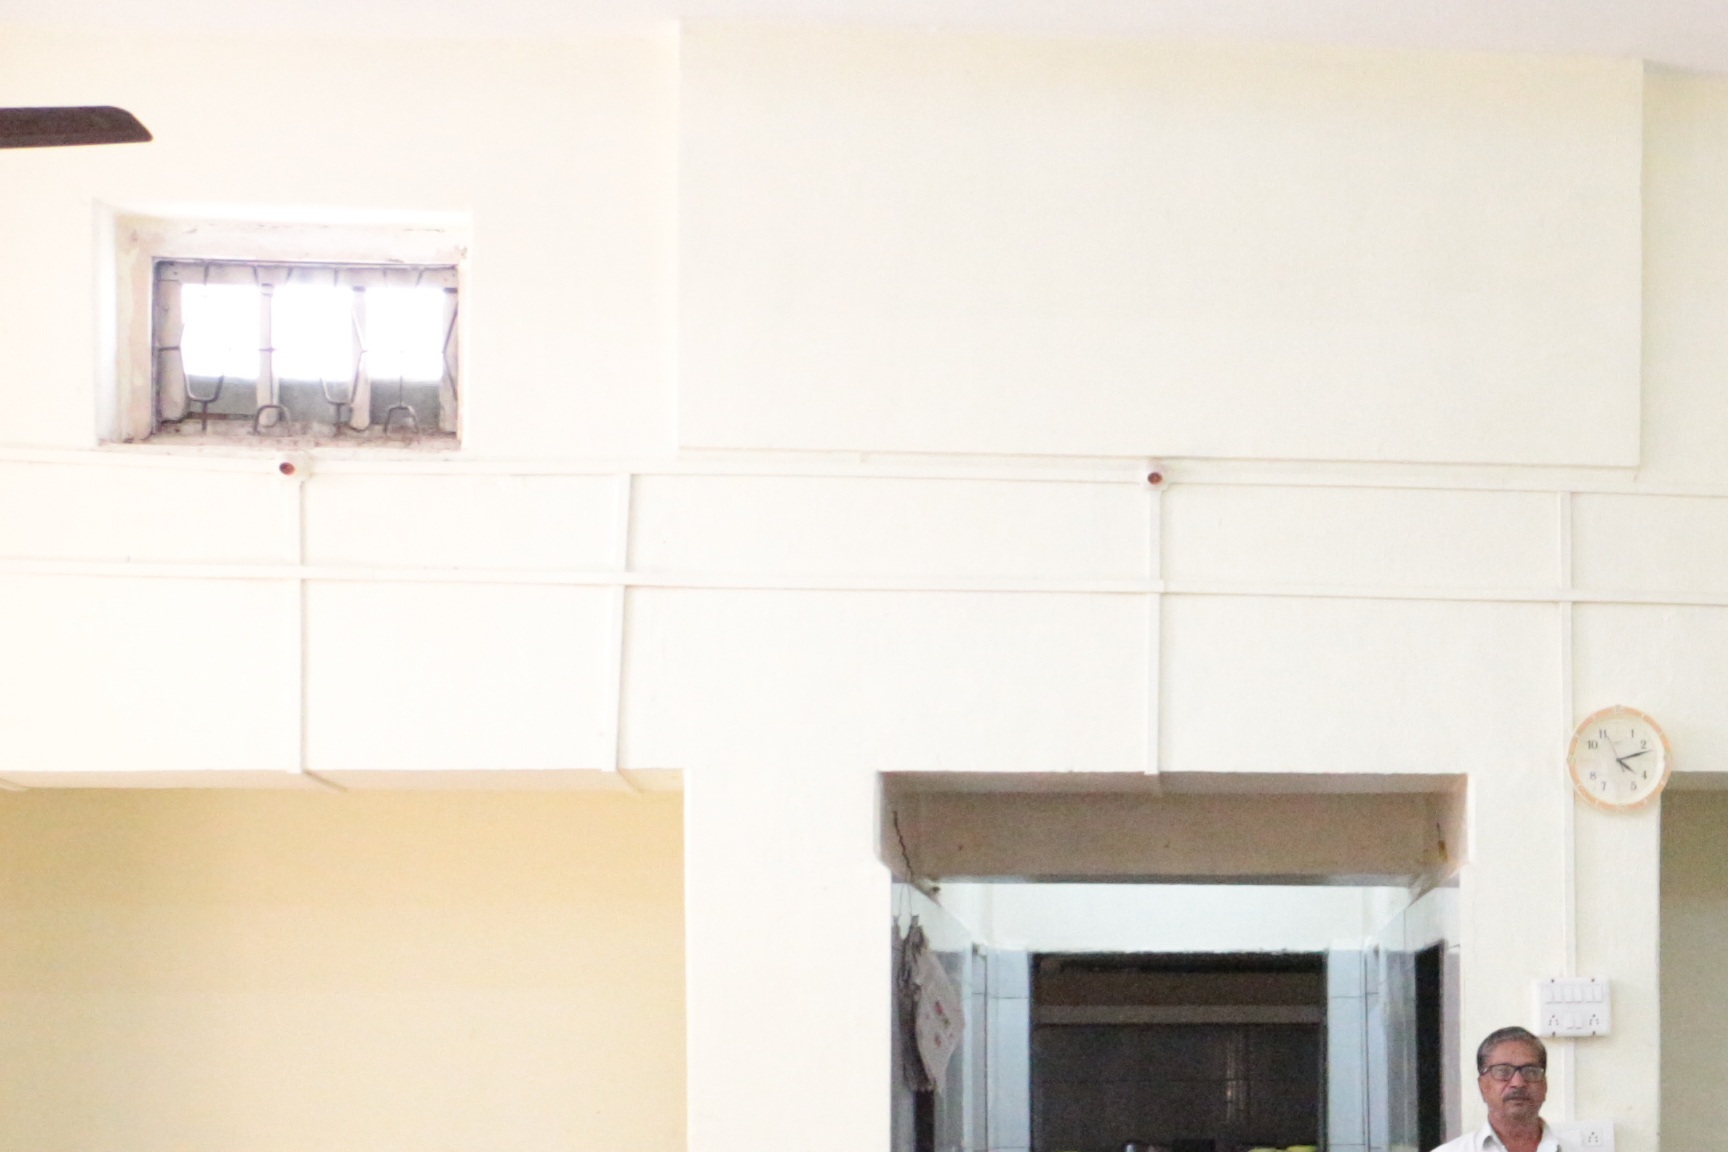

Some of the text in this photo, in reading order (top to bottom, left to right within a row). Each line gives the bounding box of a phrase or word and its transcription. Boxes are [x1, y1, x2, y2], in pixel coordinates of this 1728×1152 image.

[1598, 728, 1608, 739] 11
[1630, 728, 1635, 739] 1
[1587, 739, 1599, 750] 10
[1640, 739, 1648, 750] 2
[1589, 770, 1597, 781] 8
[1641, 770, 1648, 780] 4
[1600, 781, 1607, 792] 7
[1630, 780, 1638, 791] 5
